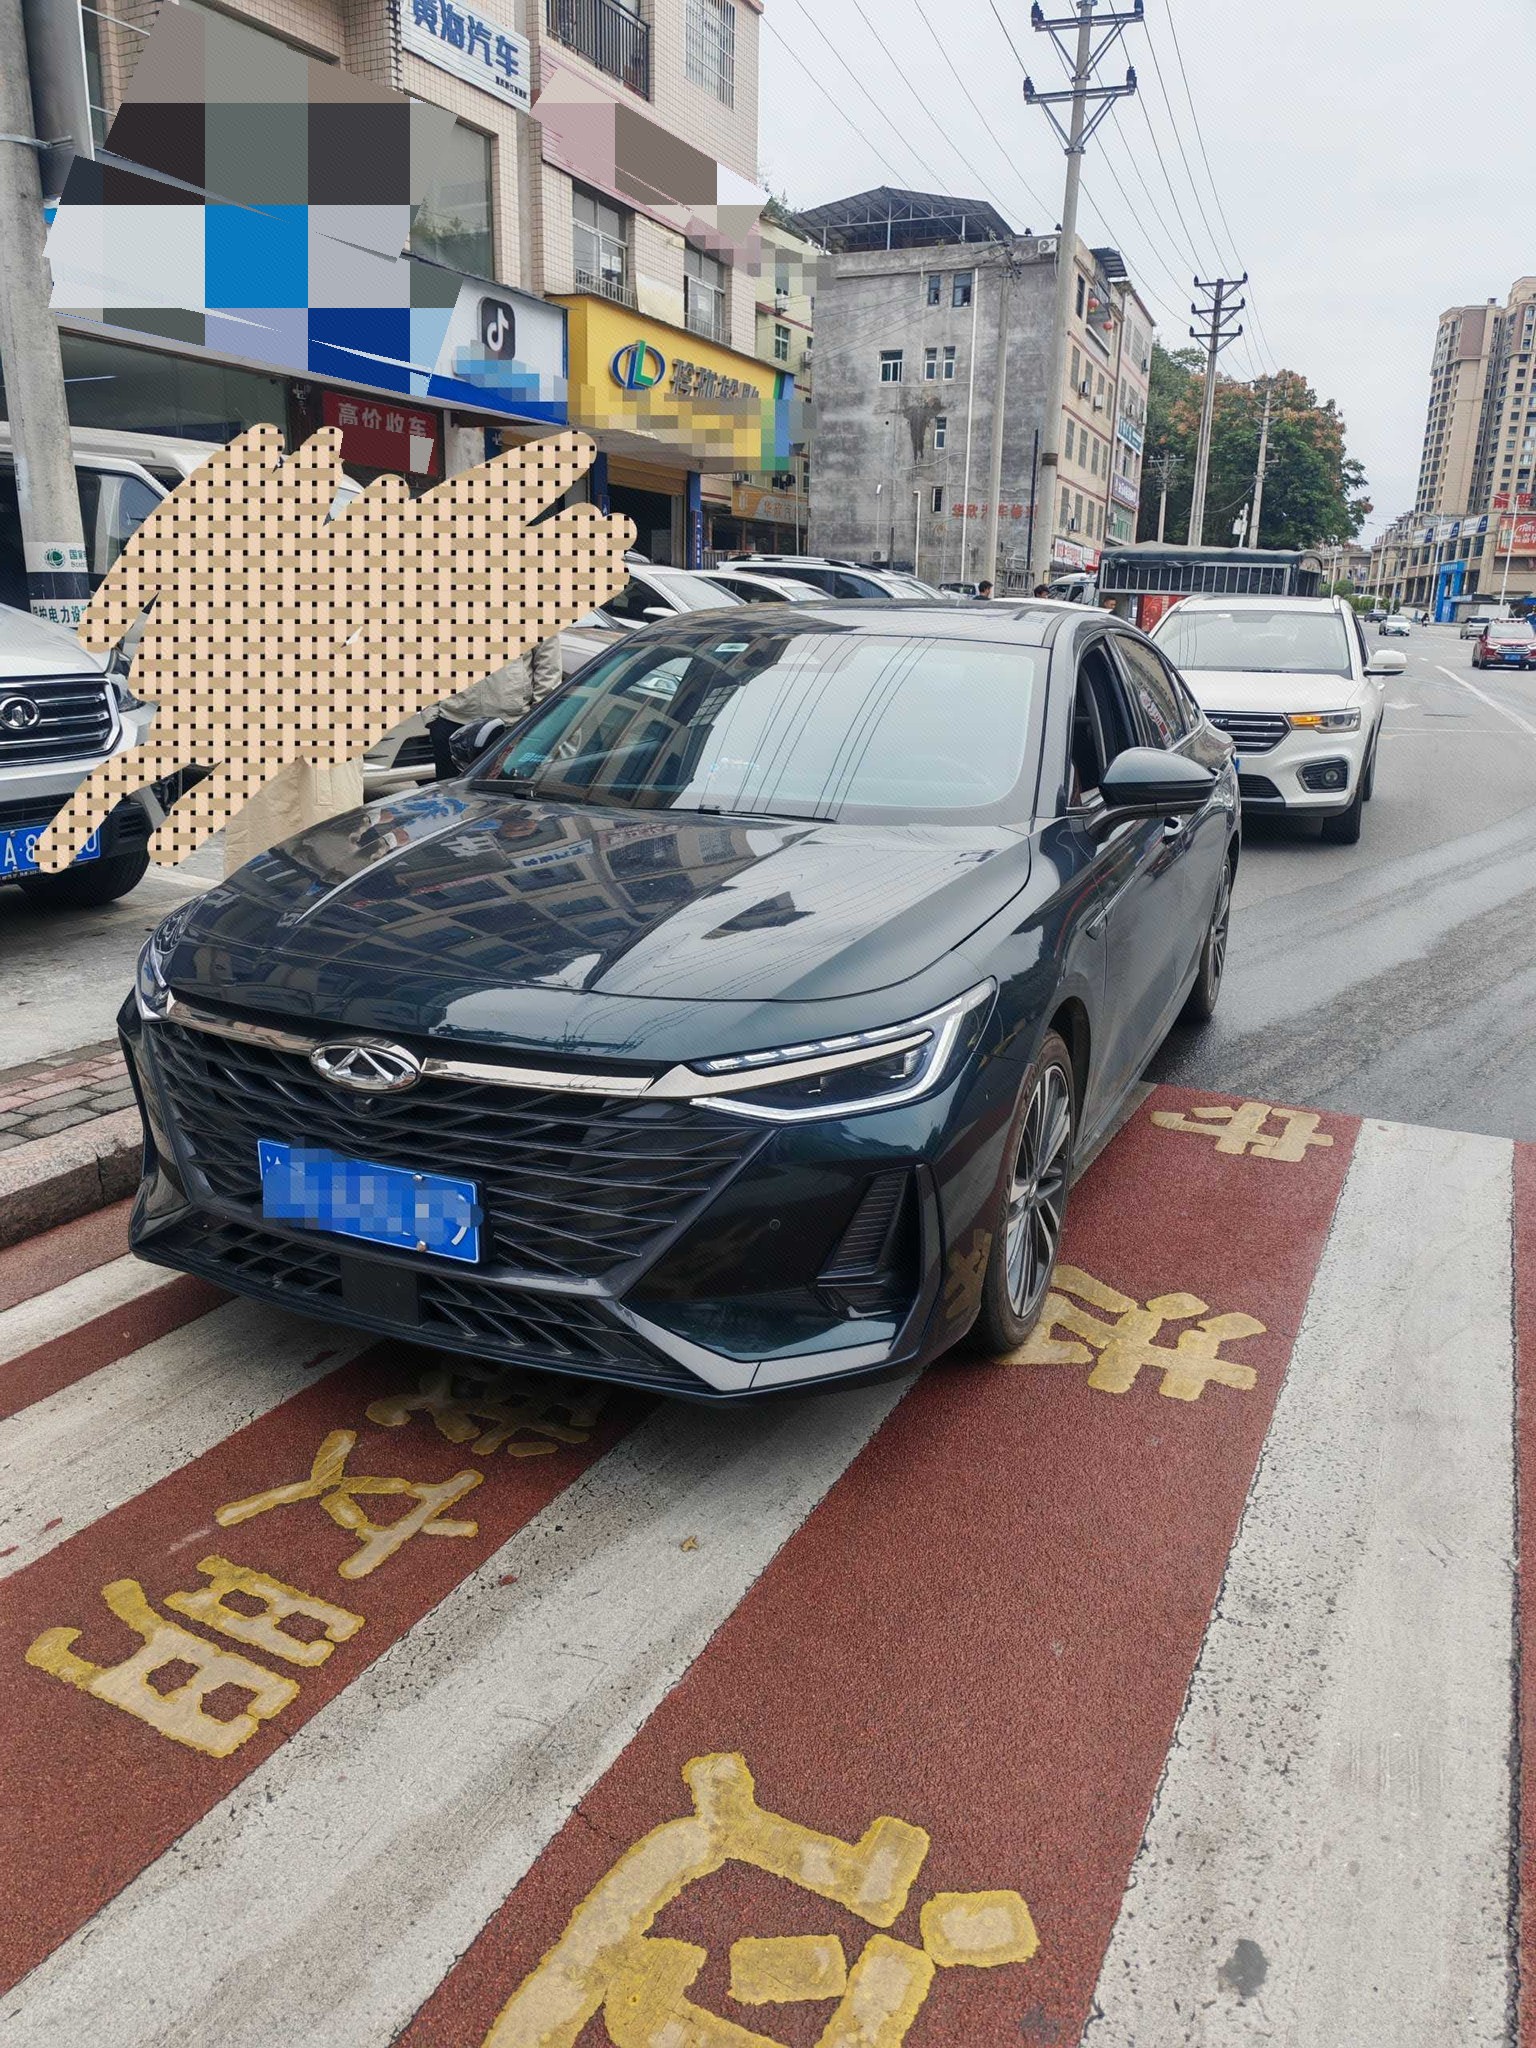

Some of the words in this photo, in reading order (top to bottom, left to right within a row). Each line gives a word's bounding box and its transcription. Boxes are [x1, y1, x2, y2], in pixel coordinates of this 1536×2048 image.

[412, 0, 519, 77] 黄海汽车
[337, 402, 427, 437] 高价收车
